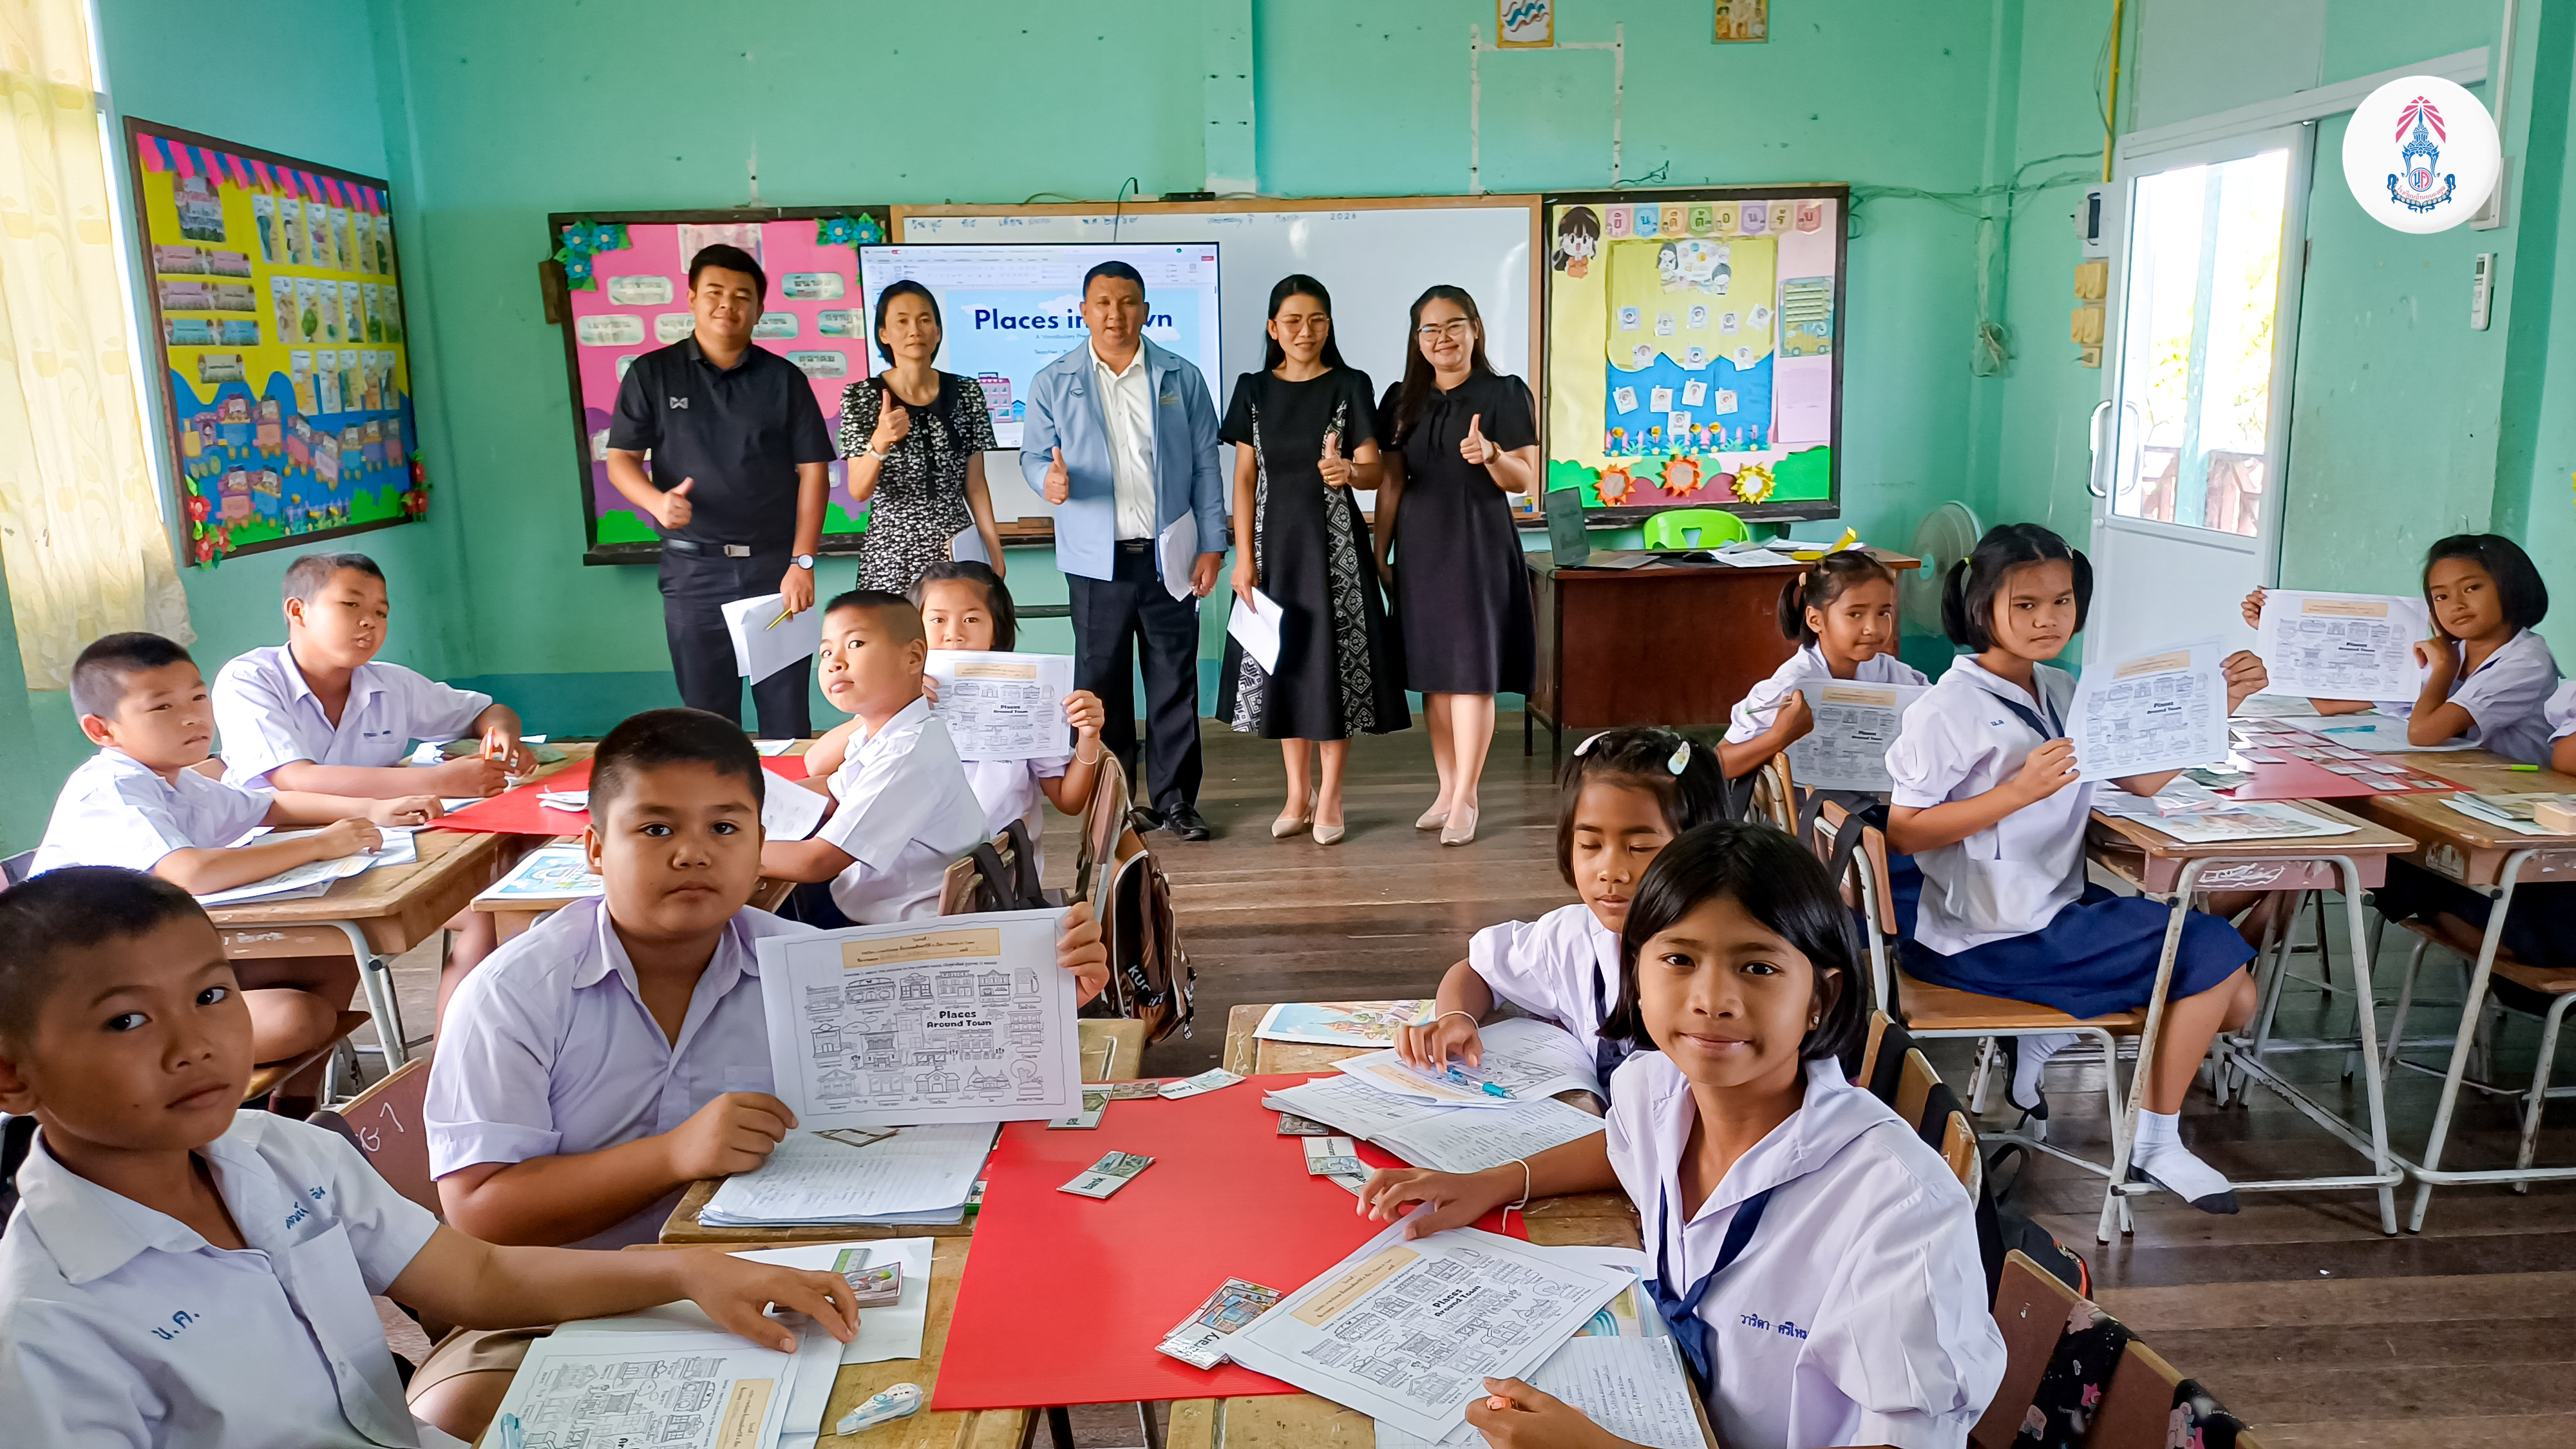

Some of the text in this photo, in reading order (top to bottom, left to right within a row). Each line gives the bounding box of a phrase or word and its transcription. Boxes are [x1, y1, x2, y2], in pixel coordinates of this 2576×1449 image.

[975, 308, 1059, 330] Places
[1081, 1177, 1106, 1189] bank
[1432, 1289, 1463, 1307] Places
[1434, 1285, 1481, 1316] Around Town
